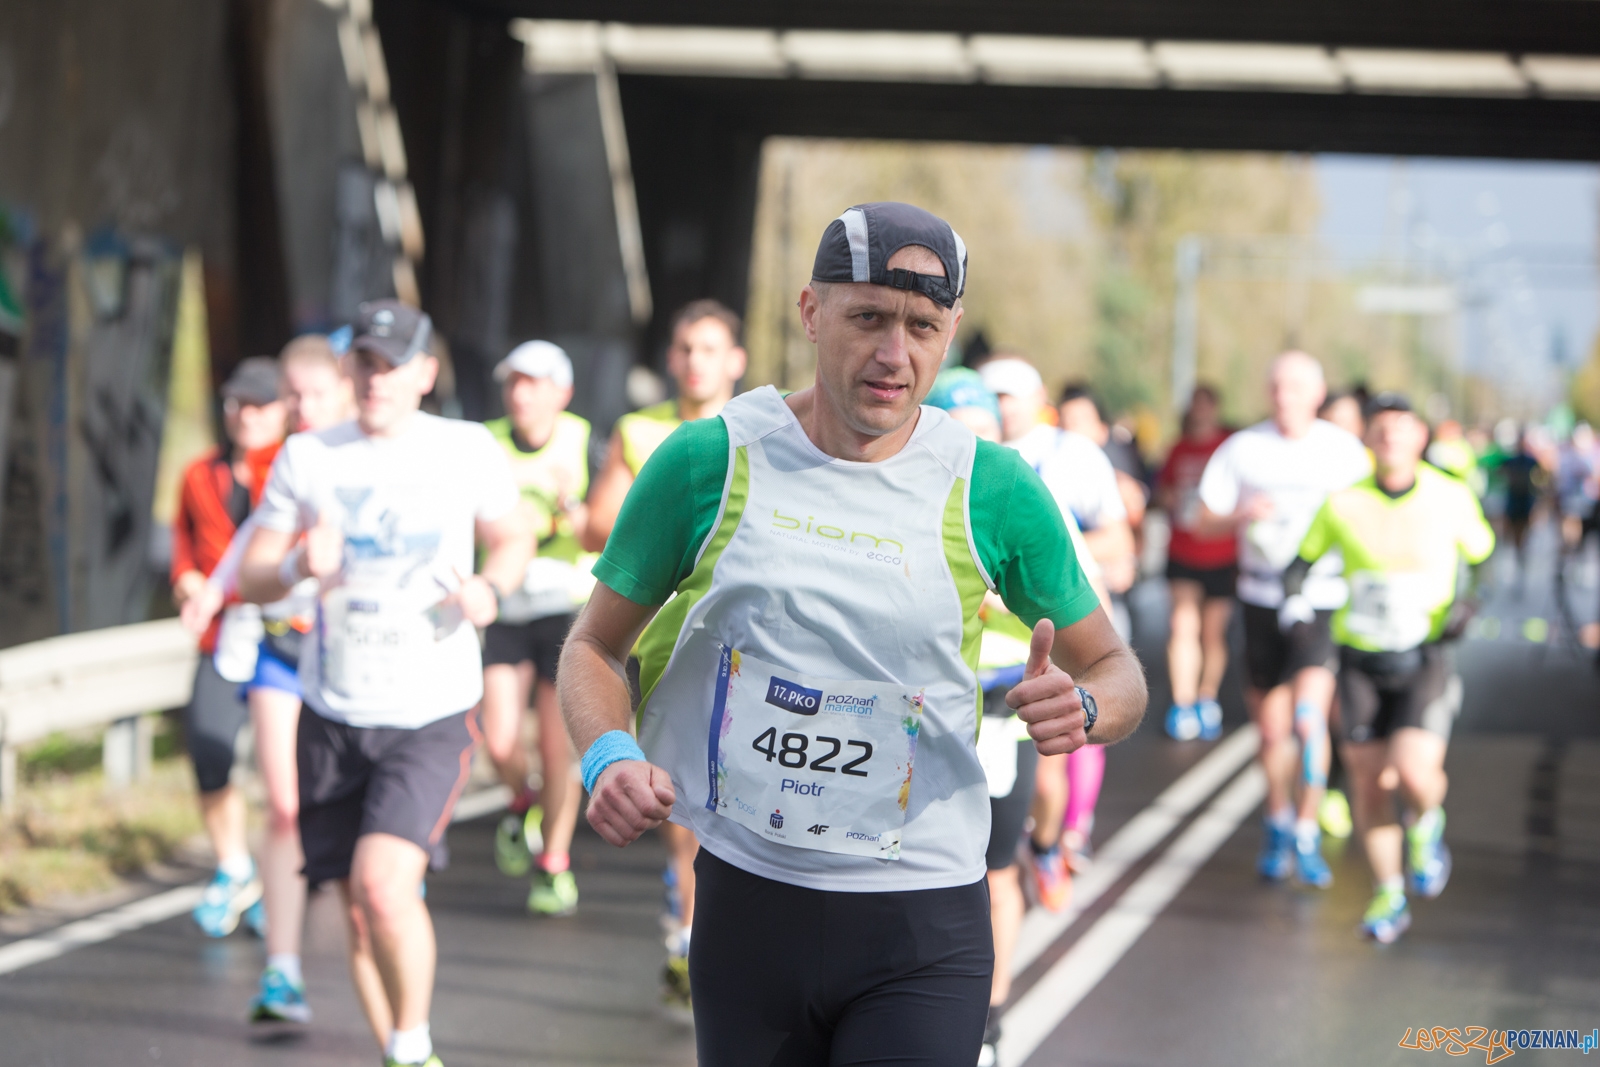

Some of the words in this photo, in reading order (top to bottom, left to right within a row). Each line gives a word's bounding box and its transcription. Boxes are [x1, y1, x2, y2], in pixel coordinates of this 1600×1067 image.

[772, 509, 904, 553] biom
[769, 529, 808, 544] NATURAL
[811, 540, 847, 553] MOTION
[866, 551, 901, 565] ecco
[824, 704, 873, 715] maraton
[752, 726, 874, 778] 4822
[780, 778, 825, 797] Piotr
[807, 823, 830, 836] 4F
